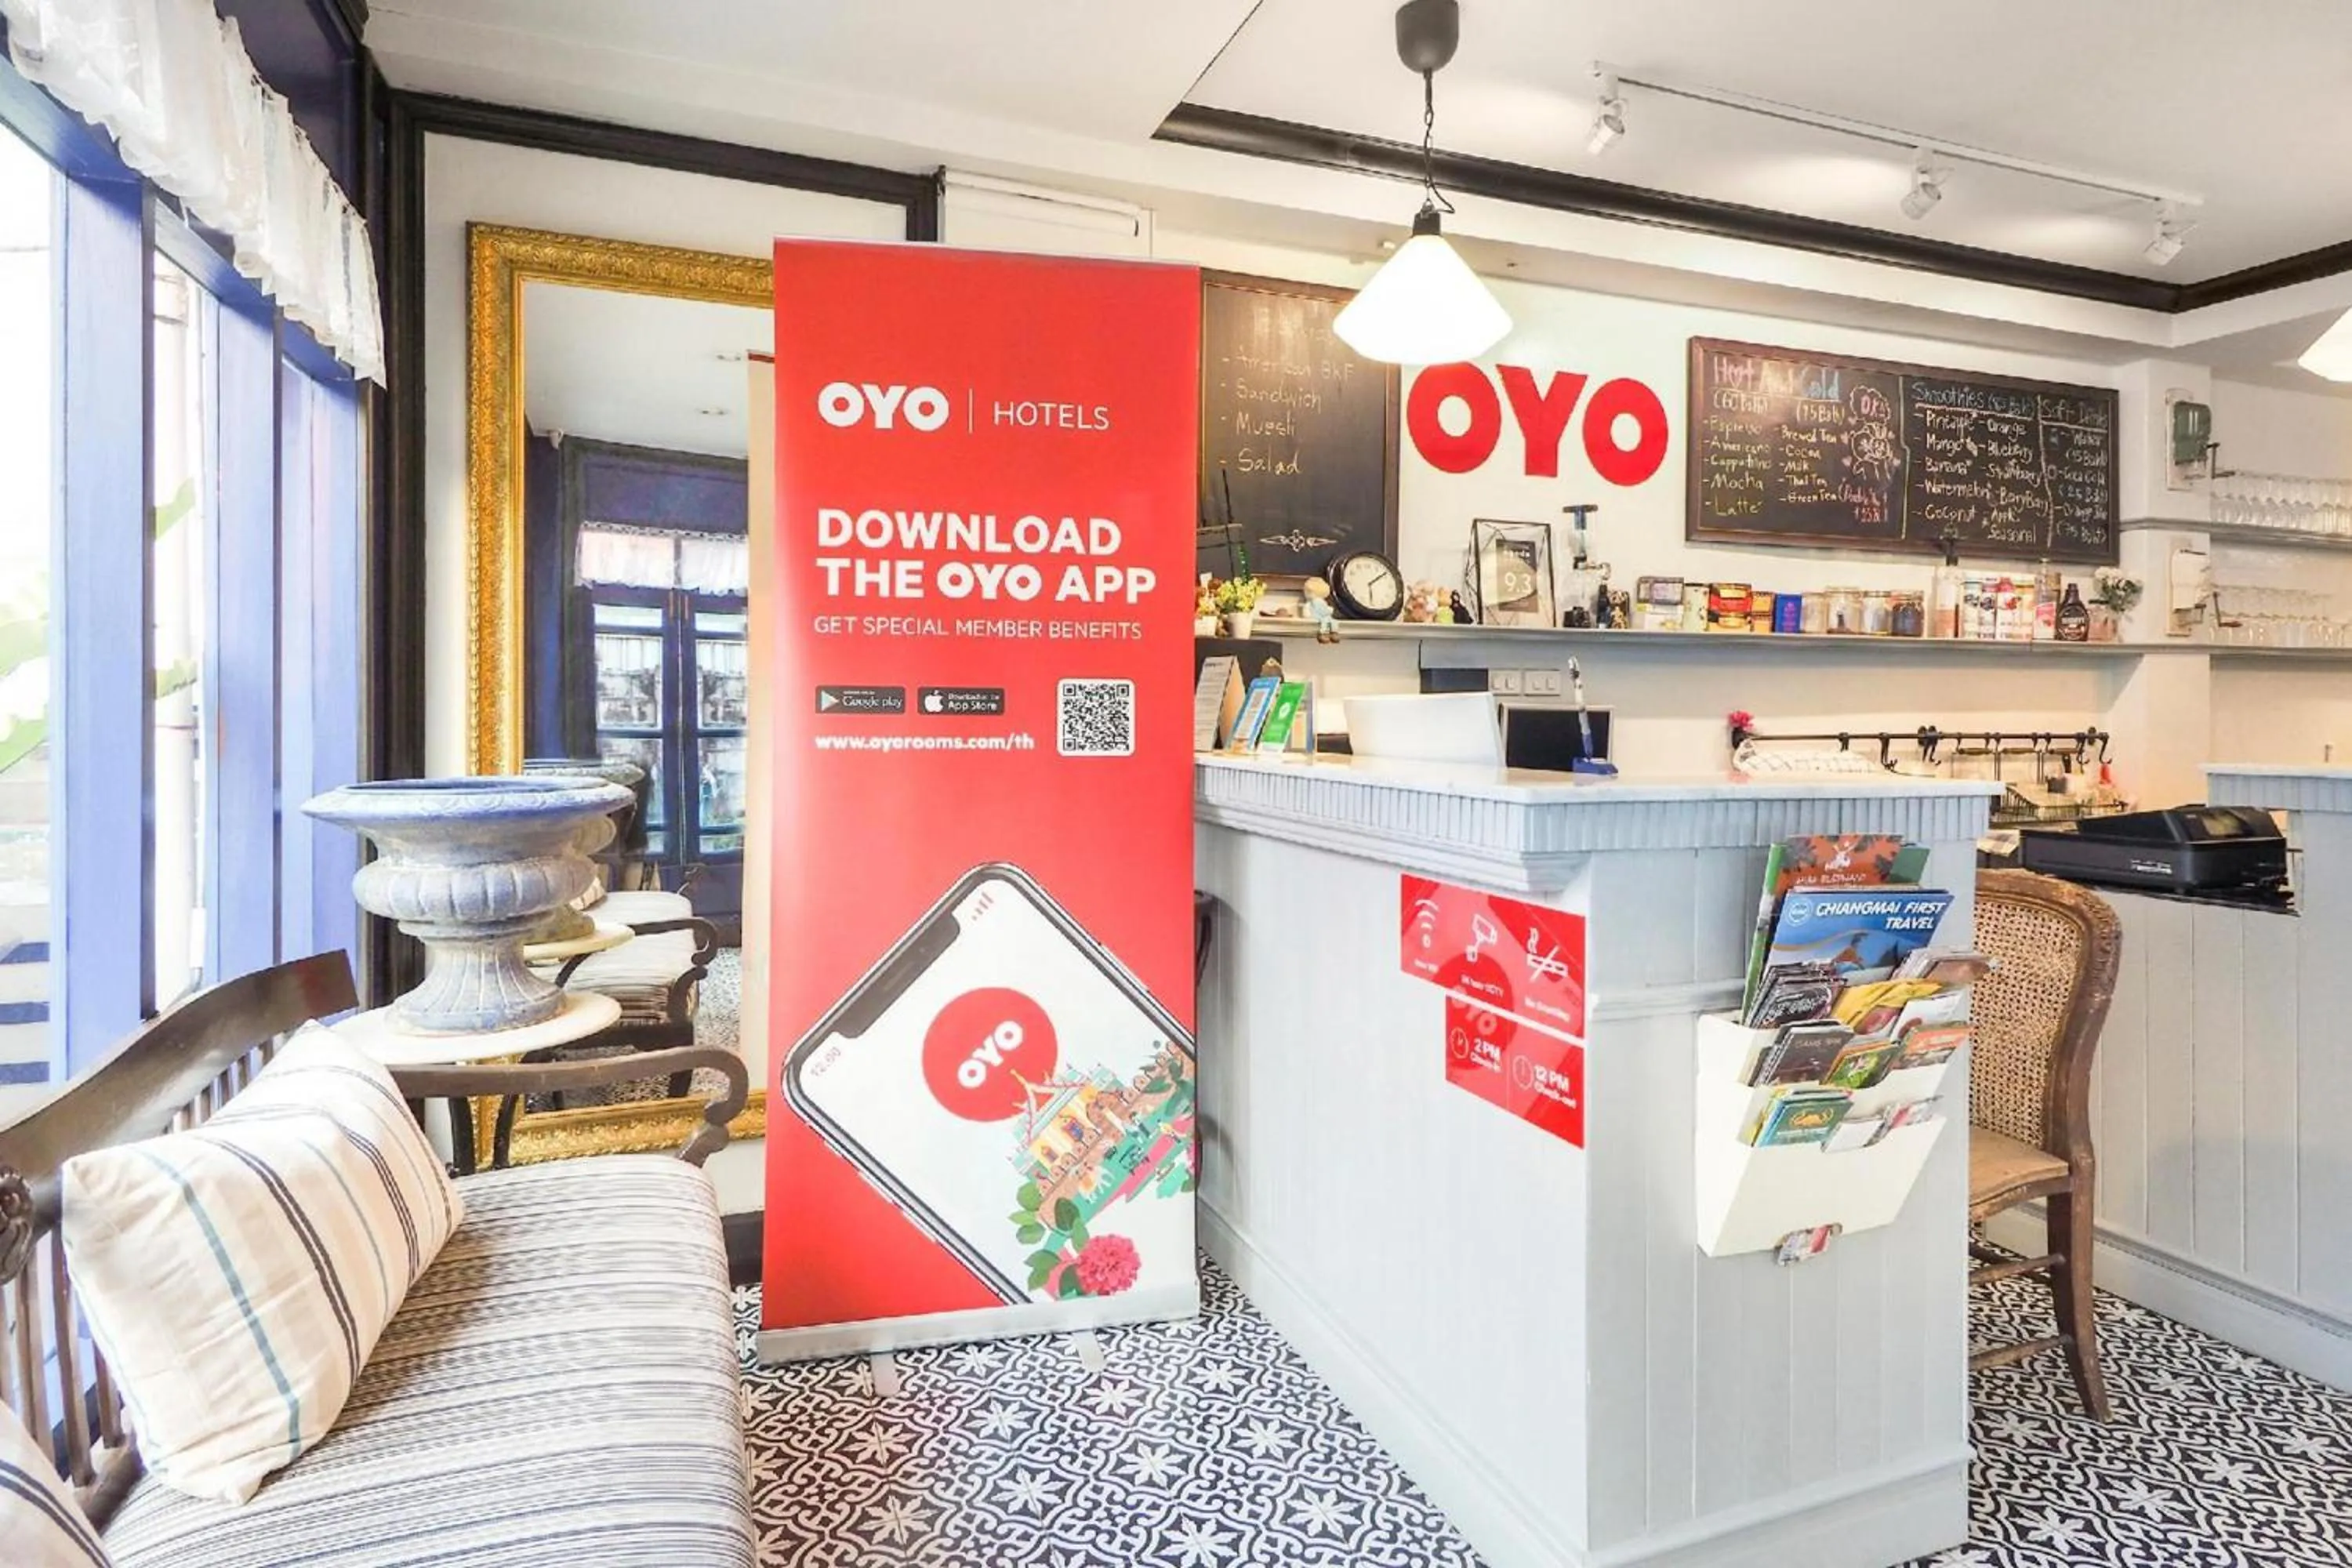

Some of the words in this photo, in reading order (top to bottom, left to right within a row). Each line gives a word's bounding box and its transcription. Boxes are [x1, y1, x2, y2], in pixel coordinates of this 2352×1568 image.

[817, 381, 949, 432] OYO
[994, 401, 1110, 431] HOTELS
[1236, 378, 1322, 414] Sandwich
[1406, 361, 1669, 487] OYO
[1237, 448, 1301, 475] Salad
[1711, 470, 1764, 491] Mocha
[818, 507, 1123, 556] DOWNLOAD
[815, 557, 924, 598] THE
[936, 561, 1043, 602] OYO
[1054, 564, 1156, 604] APP
[814, 616, 858, 634] GET
[863, 617, 949, 636] SPECIAL
[956, 620, 1042, 638] MEMBER
[1049, 620, 1143, 640] BENEFITS
[842, 695, 880, 709] Google
[948, 701, 968, 712] App
[971, 702, 997, 711] Store
[815, 732, 1035, 753] www.oyorooms.com/th
[1904, 902, 1947, 914] FIRST
[1885, 916, 1934, 930] TRAVEL
[957, 1020, 1024, 1089] OYO
[1474, 1038, 1482, 1053] 2
[1483, 1041, 1501, 1061] PM
[1549, 1070, 1570, 1093] PM
